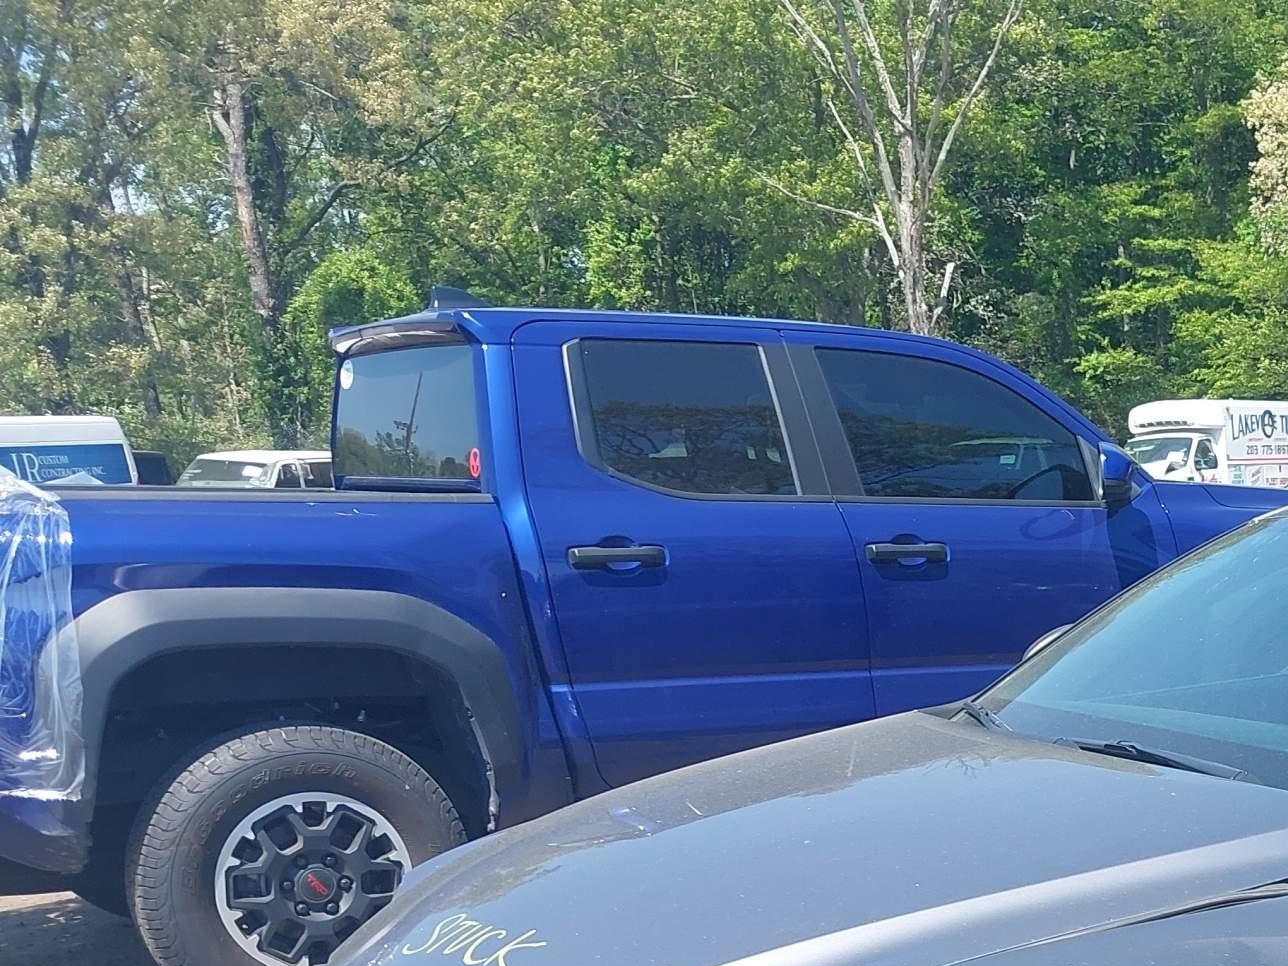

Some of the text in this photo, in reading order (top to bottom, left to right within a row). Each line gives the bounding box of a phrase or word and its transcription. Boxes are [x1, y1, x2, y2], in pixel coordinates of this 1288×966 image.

[1246, 444, 1259, 455] 203
[38, 455, 69, 465] CUSTOM
[306, 872, 329, 896] TRD
